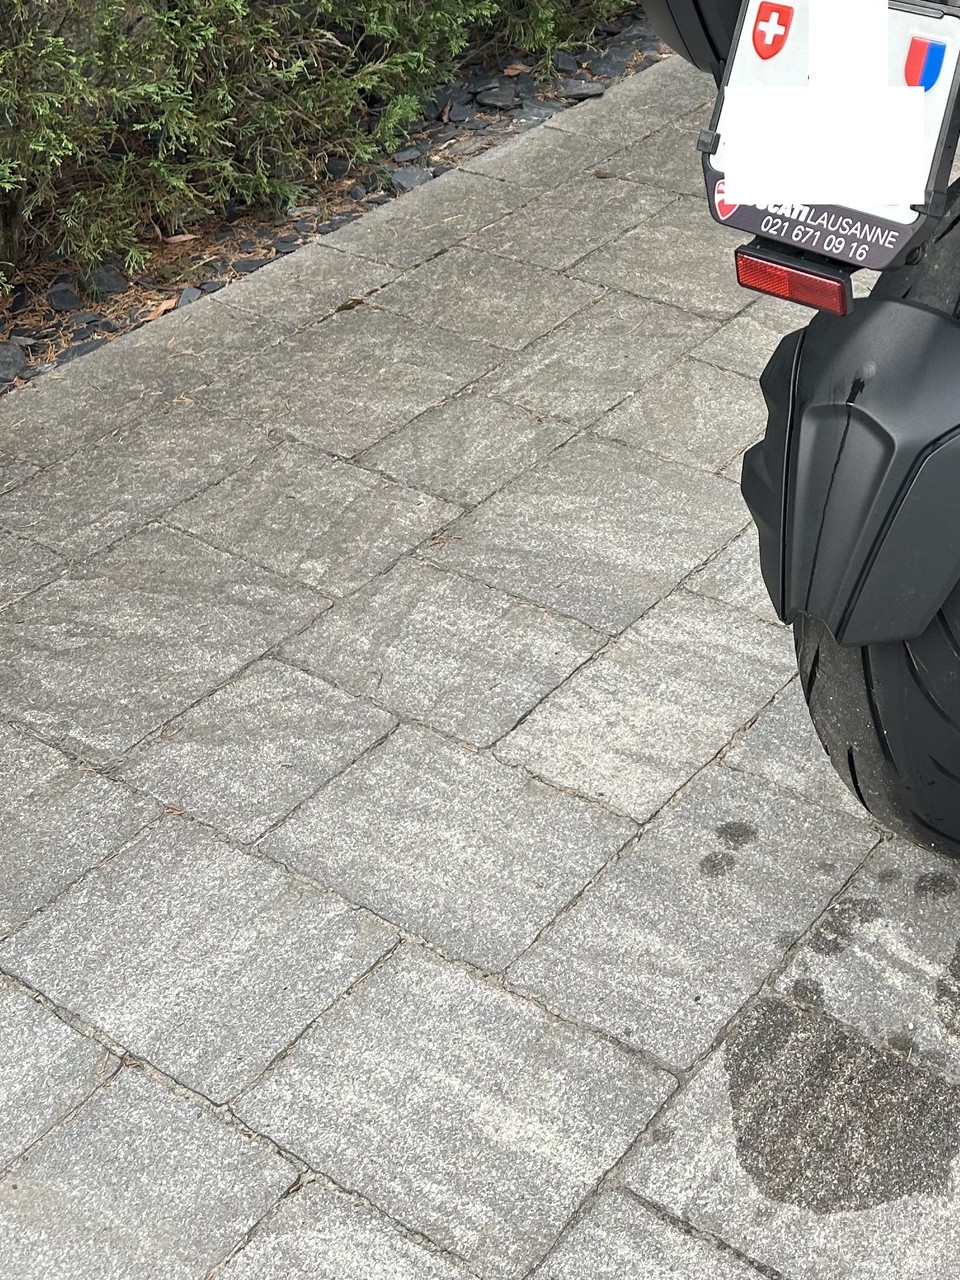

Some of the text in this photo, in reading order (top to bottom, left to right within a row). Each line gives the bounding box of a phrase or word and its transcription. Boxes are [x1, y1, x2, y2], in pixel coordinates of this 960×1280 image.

[760, 215, 870, 261] 021 671 09 16
[806, 207, 900, 249] LAUSANNE
